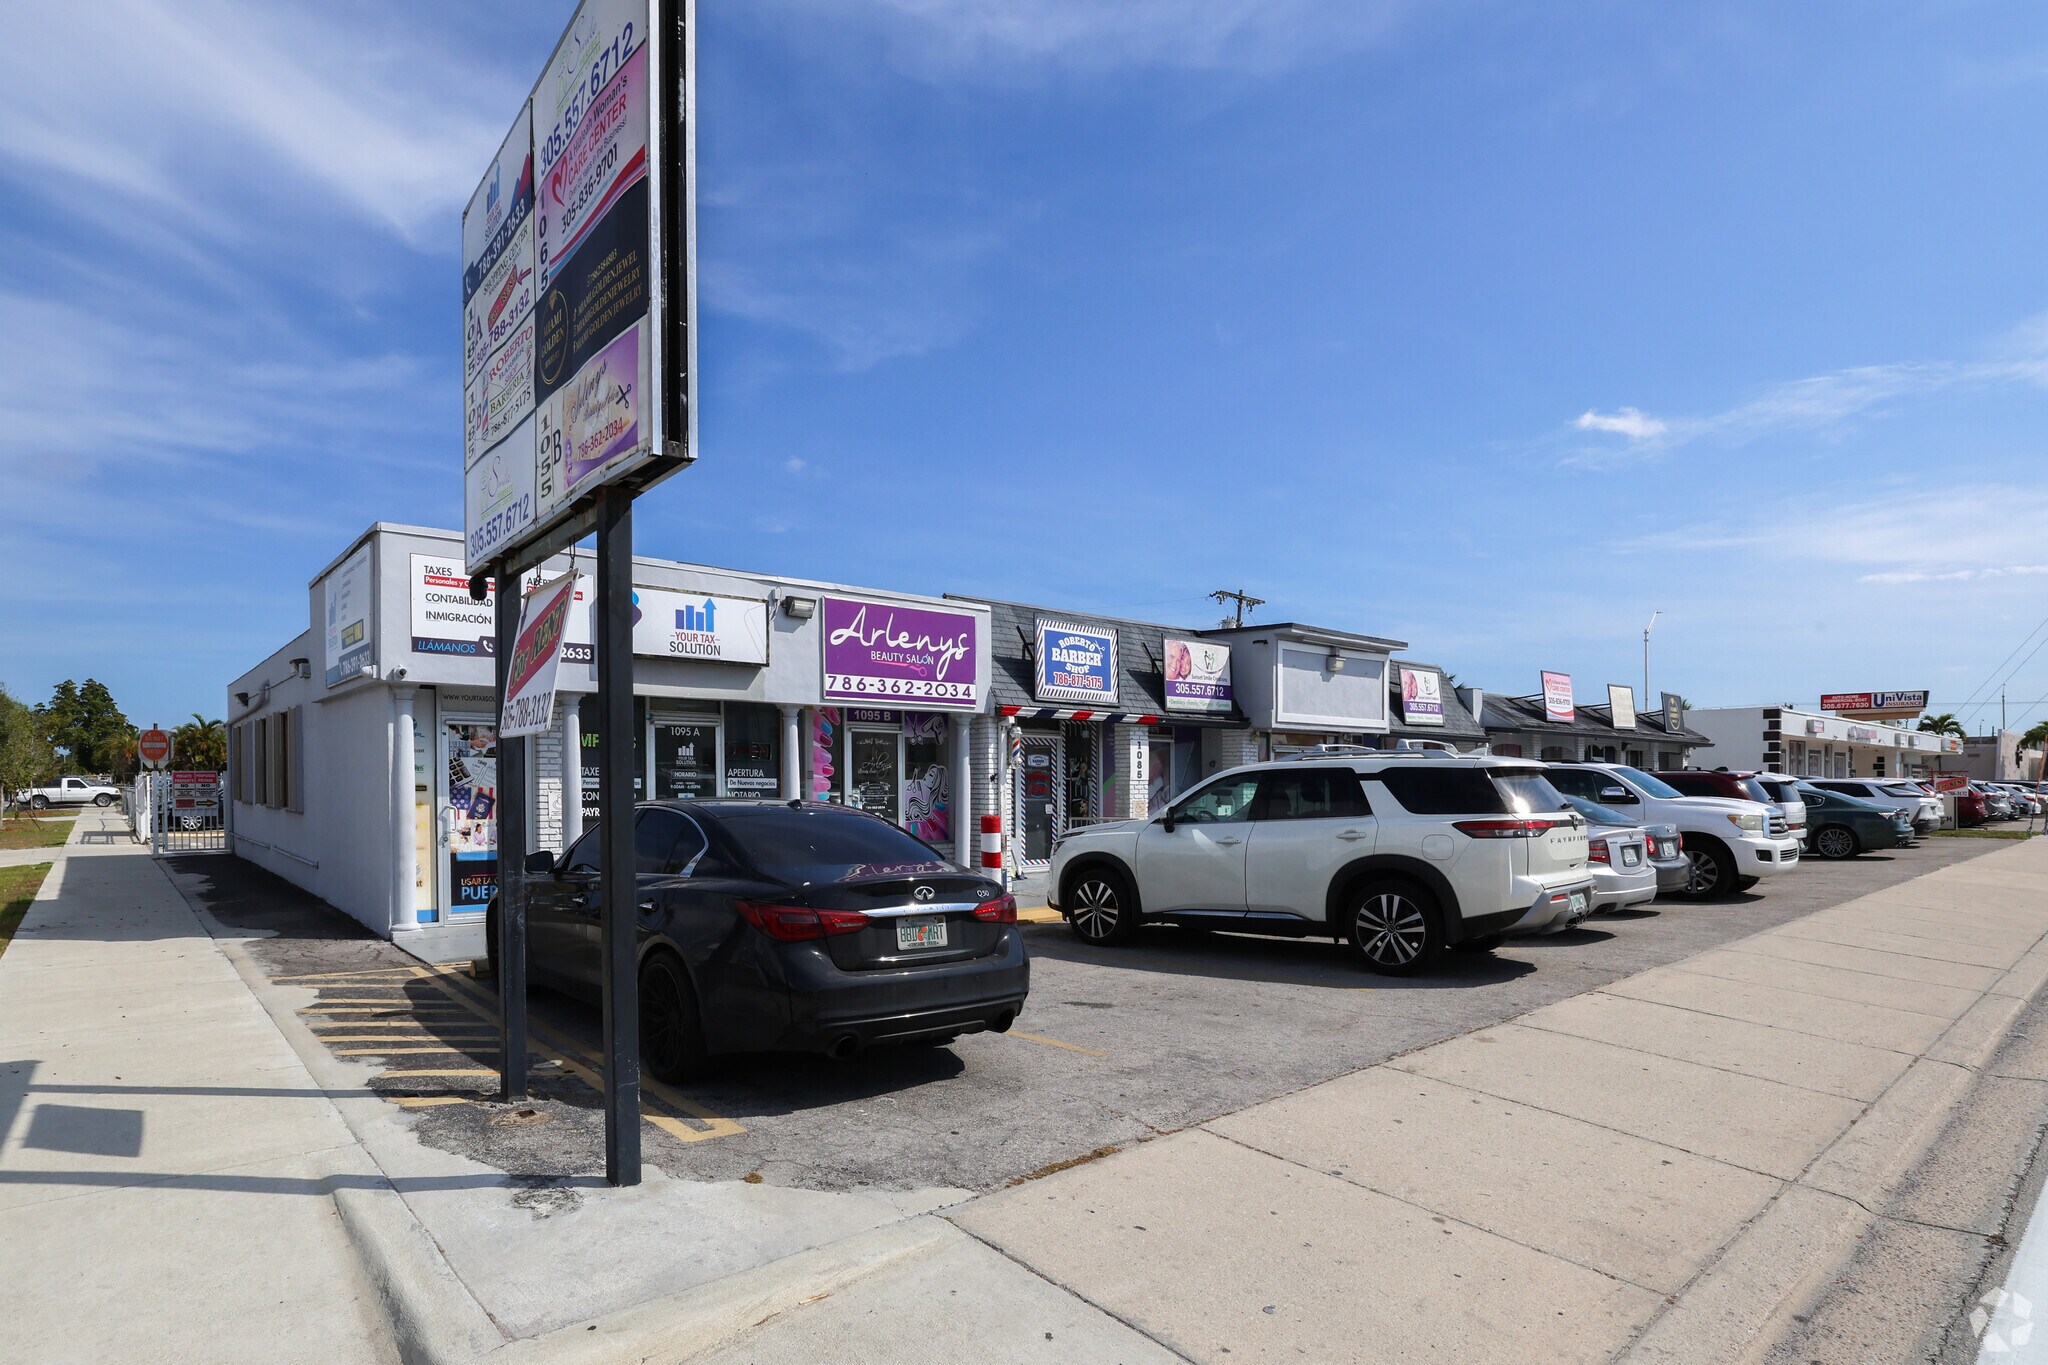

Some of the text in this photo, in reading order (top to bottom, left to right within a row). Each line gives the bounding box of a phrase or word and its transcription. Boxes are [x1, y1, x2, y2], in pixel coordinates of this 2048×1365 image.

[541, 21, 633, 177] 305.557.6712
[593, 74, 628, 121] Woman's
[568, 147, 588, 185] CARE
[588, 93, 627, 152] CENTER
[562, 143, 618, 234] 305-836-9701
[479, 198, 525, 281] 786-391-2633
[476, 287, 530, 366] 305-788-3132
[543, 308, 562, 334] MIAMI
[489, 325, 533, 382] ROBERTO
[490, 371, 525, 414] BARBERIA
[490, 386, 531, 437] 786-877-5175
[578, 417, 624, 460] 786-362-2034
[553, 428, 562, 466] B
[470, 493, 529, 558] 305.557.6712
[424, 564, 452, 577] TAXES
[425, 576, 458, 587] Personales
[458, 579, 463, 588] y
[425, 593, 493, 607] CONTABILIDAD
[425, 610, 492, 625] INMIGRACIÓN
[530, 593, 567, 664] RENT
[418, 639, 476, 653] LLÁMANOS
[675, 632, 716, 644] YOUR TAX
[830, 605, 970, 681] Arlenys
[1058, 636, 1096, 652] ROBERTO
[669, 641, 721, 656] SOLUTION
[871, 650, 934, 665] BEAUTY SALON
[1051, 647, 1102, 667] BARBER
[1065, 662, 1090, 674] SHOP
[828, 675, 971, 698] 786-362-2034
[1053, 672, 1103, 689] 786-877-5175
[1175, 683, 1224, 697] 305.557.6712
[1873, 692, 1923, 708] UniVista
[502, 691, 551, 731] 305-788-3132
[854, 709, 891, 721] 1095 B
[671, 726, 700, 736] 1095 A
[581, 766, 600, 776] TAXE
[727, 768, 765, 778] APERTURA
[581, 807, 600, 817] PAYR
[461, 878, 482, 886] USAR
[976, 889, 990, 898] Q50
